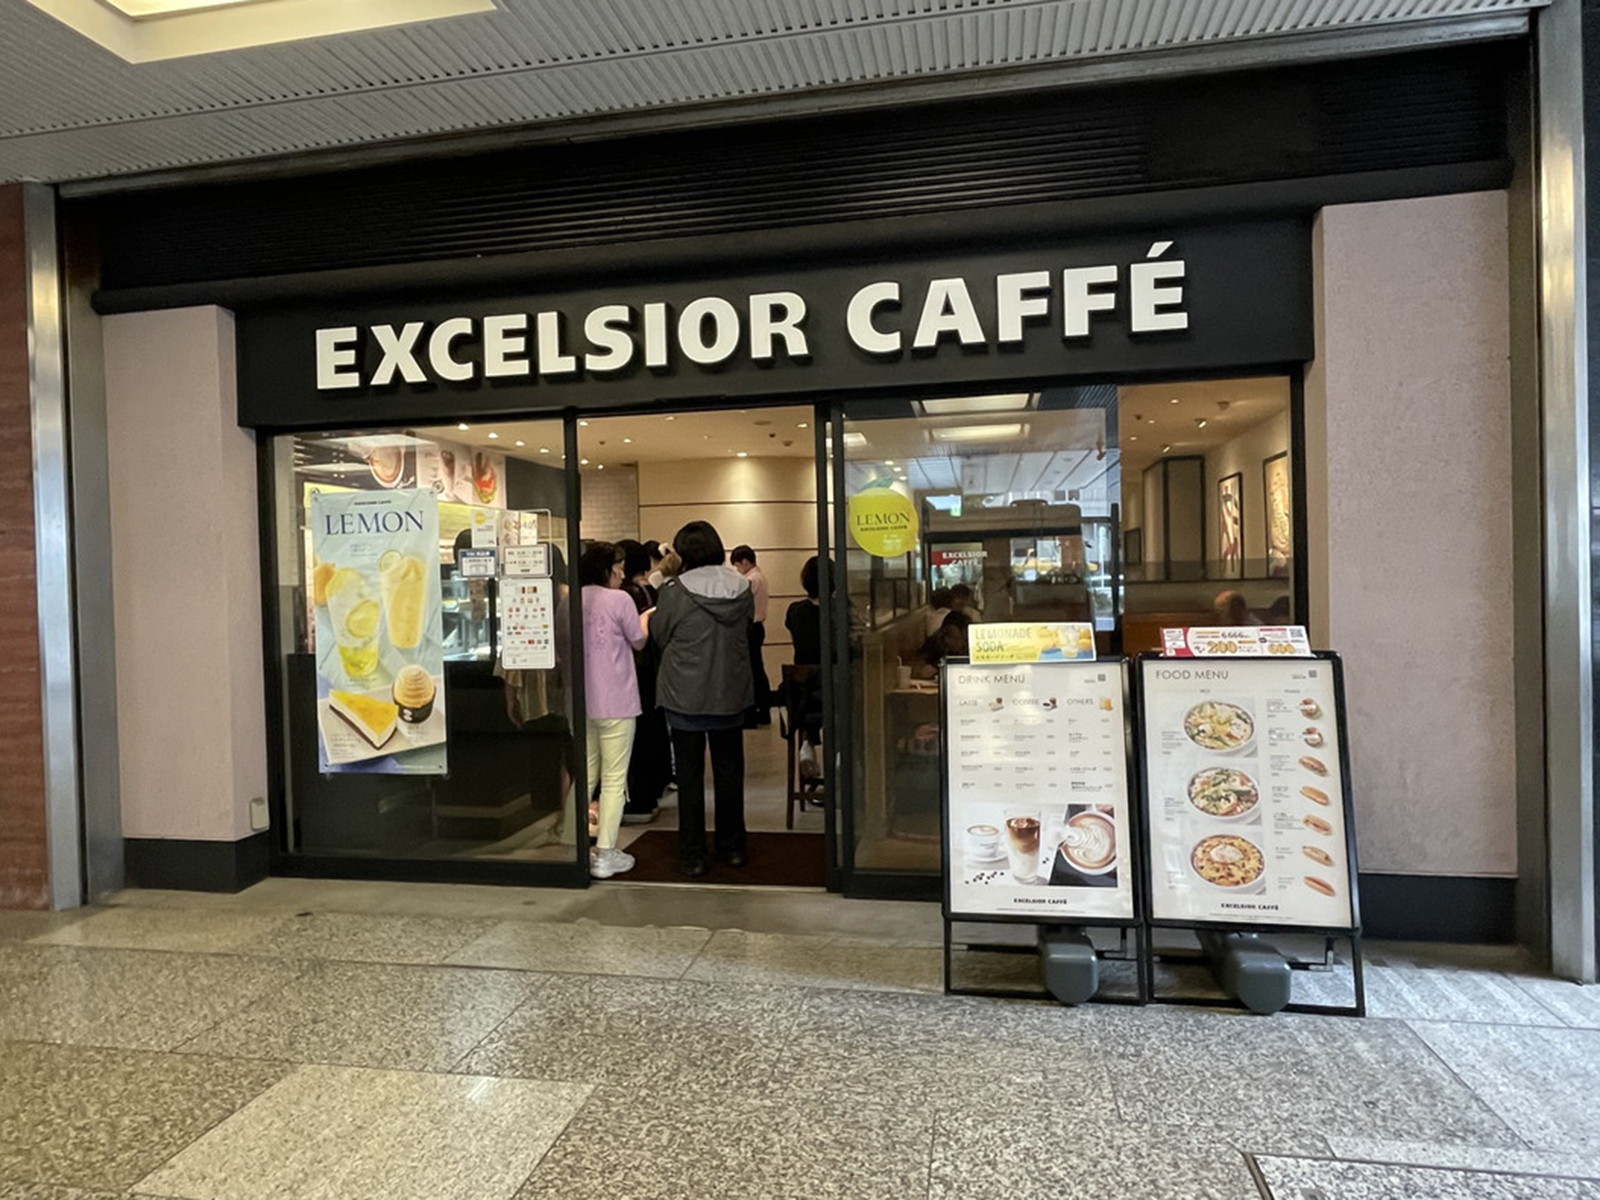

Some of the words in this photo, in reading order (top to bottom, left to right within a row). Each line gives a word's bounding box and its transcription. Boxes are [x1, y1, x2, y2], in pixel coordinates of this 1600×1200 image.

[315, 290, 809, 391] EXCELSIOR
[846, 241, 1190, 354] CAFFÉ
[325, 510, 424, 535] LEMON
[857, 512, 910, 526] LEMON
[942, 551, 988, 559] EXCELSIOR
[975, 627, 1031, 639] LEMONADE
[976, 641, 1004, 652] SODA
[1207, 641, 1238, 654] 200
[958, 675, 991, 685] DRINK
[994, 674, 1025, 684] MENU
[1156, 670, 1190, 680] FOOD
[1195, 670, 1229, 680] MENU
[1067, 698, 1094, 706] OTHERS
